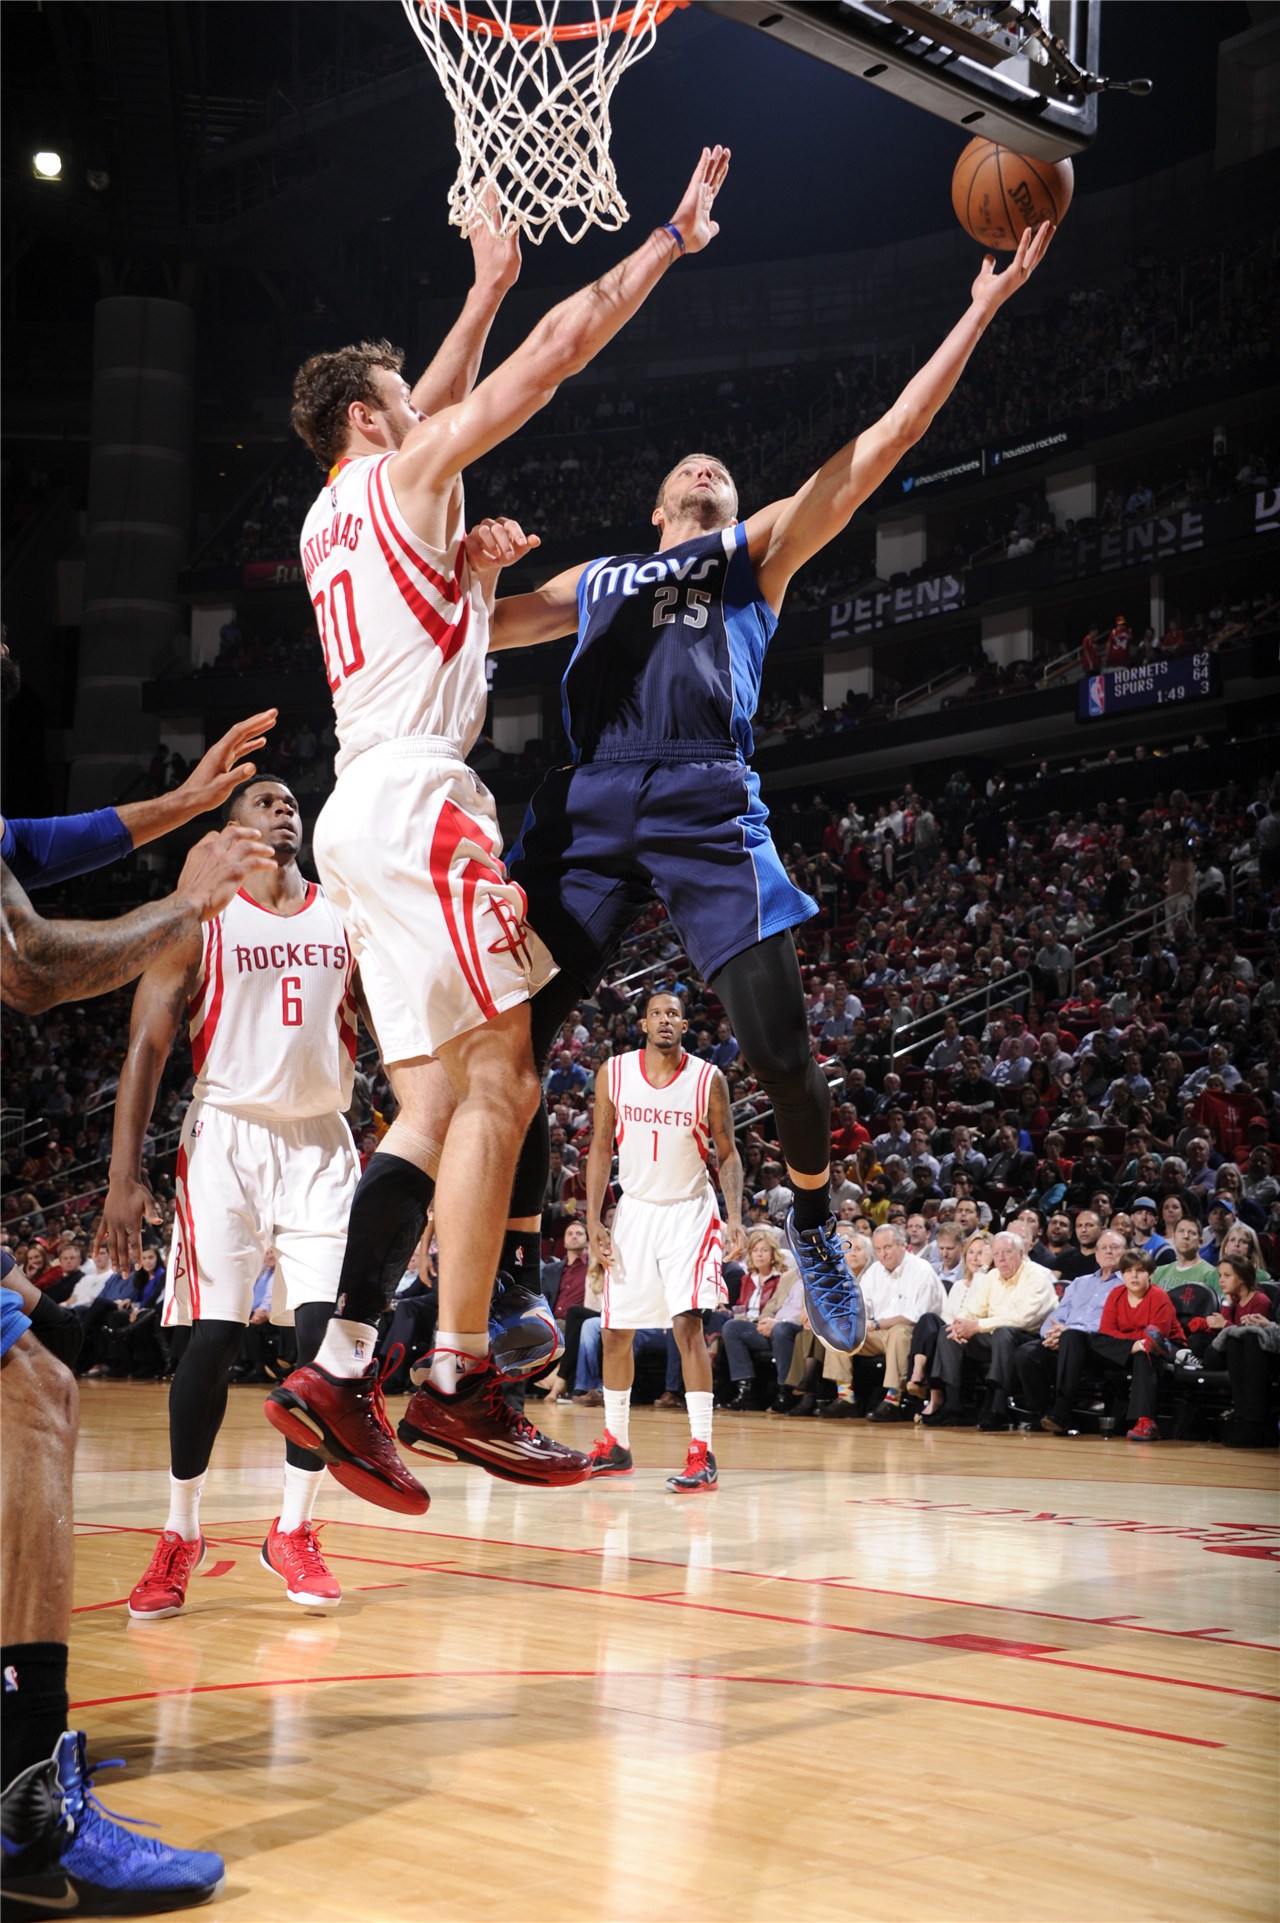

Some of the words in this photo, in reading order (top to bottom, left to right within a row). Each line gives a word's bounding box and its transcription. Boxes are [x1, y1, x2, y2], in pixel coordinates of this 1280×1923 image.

[1002, 443, 1036, 461] houston
[1036, 432, 1068, 449] rockets
[914, 460, 981, 488] @houstonrockets
[653, 586, 711, 629] 25
[1114, 661, 1168, 684] HORNETS
[1192, 652, 1210, 667] 62
[1114, 678, 1154, 698] SPURS
[1192, 666, 1210, 681] 64
[1157, 685, 1185, 704] 1:49
[1200, 680, 1210, 695] 3
[231, 943, 346, 974] ROCKETS
[281, 976, 303, 1027] 6
[622, 1104, 693, 1127] ROCKETS
[652, 1130, 658, 1162] 1
